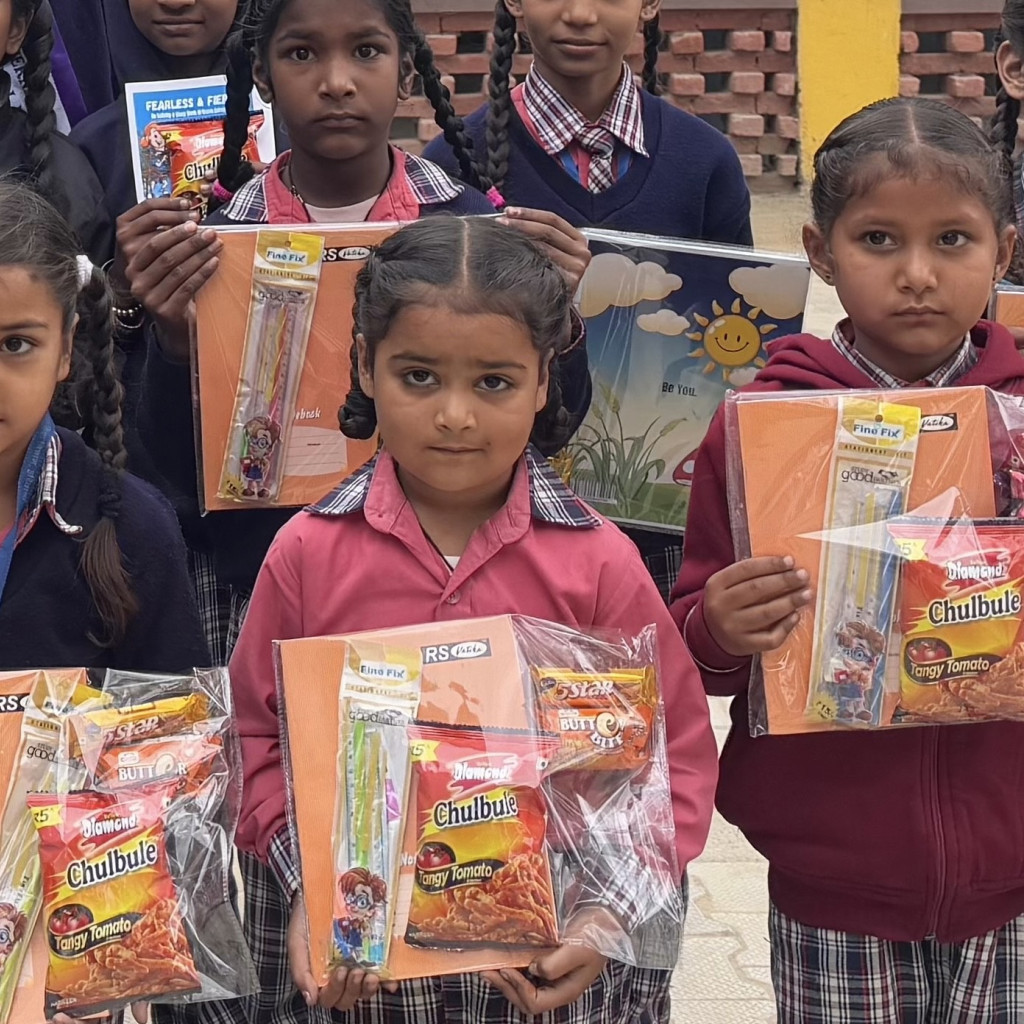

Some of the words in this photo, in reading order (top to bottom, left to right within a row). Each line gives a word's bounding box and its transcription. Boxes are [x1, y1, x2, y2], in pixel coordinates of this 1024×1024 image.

[145, 97, 194, 112] FEARLESS
[928, 589, 1021, 625] Chulbule
[425, 644, 450, 663] RS
[910, 662, 945, 679] Tangy
[946, 657, 990, 675] Tomato
[453, 762, 511, 781] Diamond
[433, 790, 518, 828] Chulbule
[81, 813, 139, 839] Diamond
[66, 840, 157, 888] Chulbule
[418, 870, 449, 887] Tangy
[451, 863, 493, 880] Tomato
[54, 931, 89, 952] Tangy
[89, 918, 132, 941] Tomato
